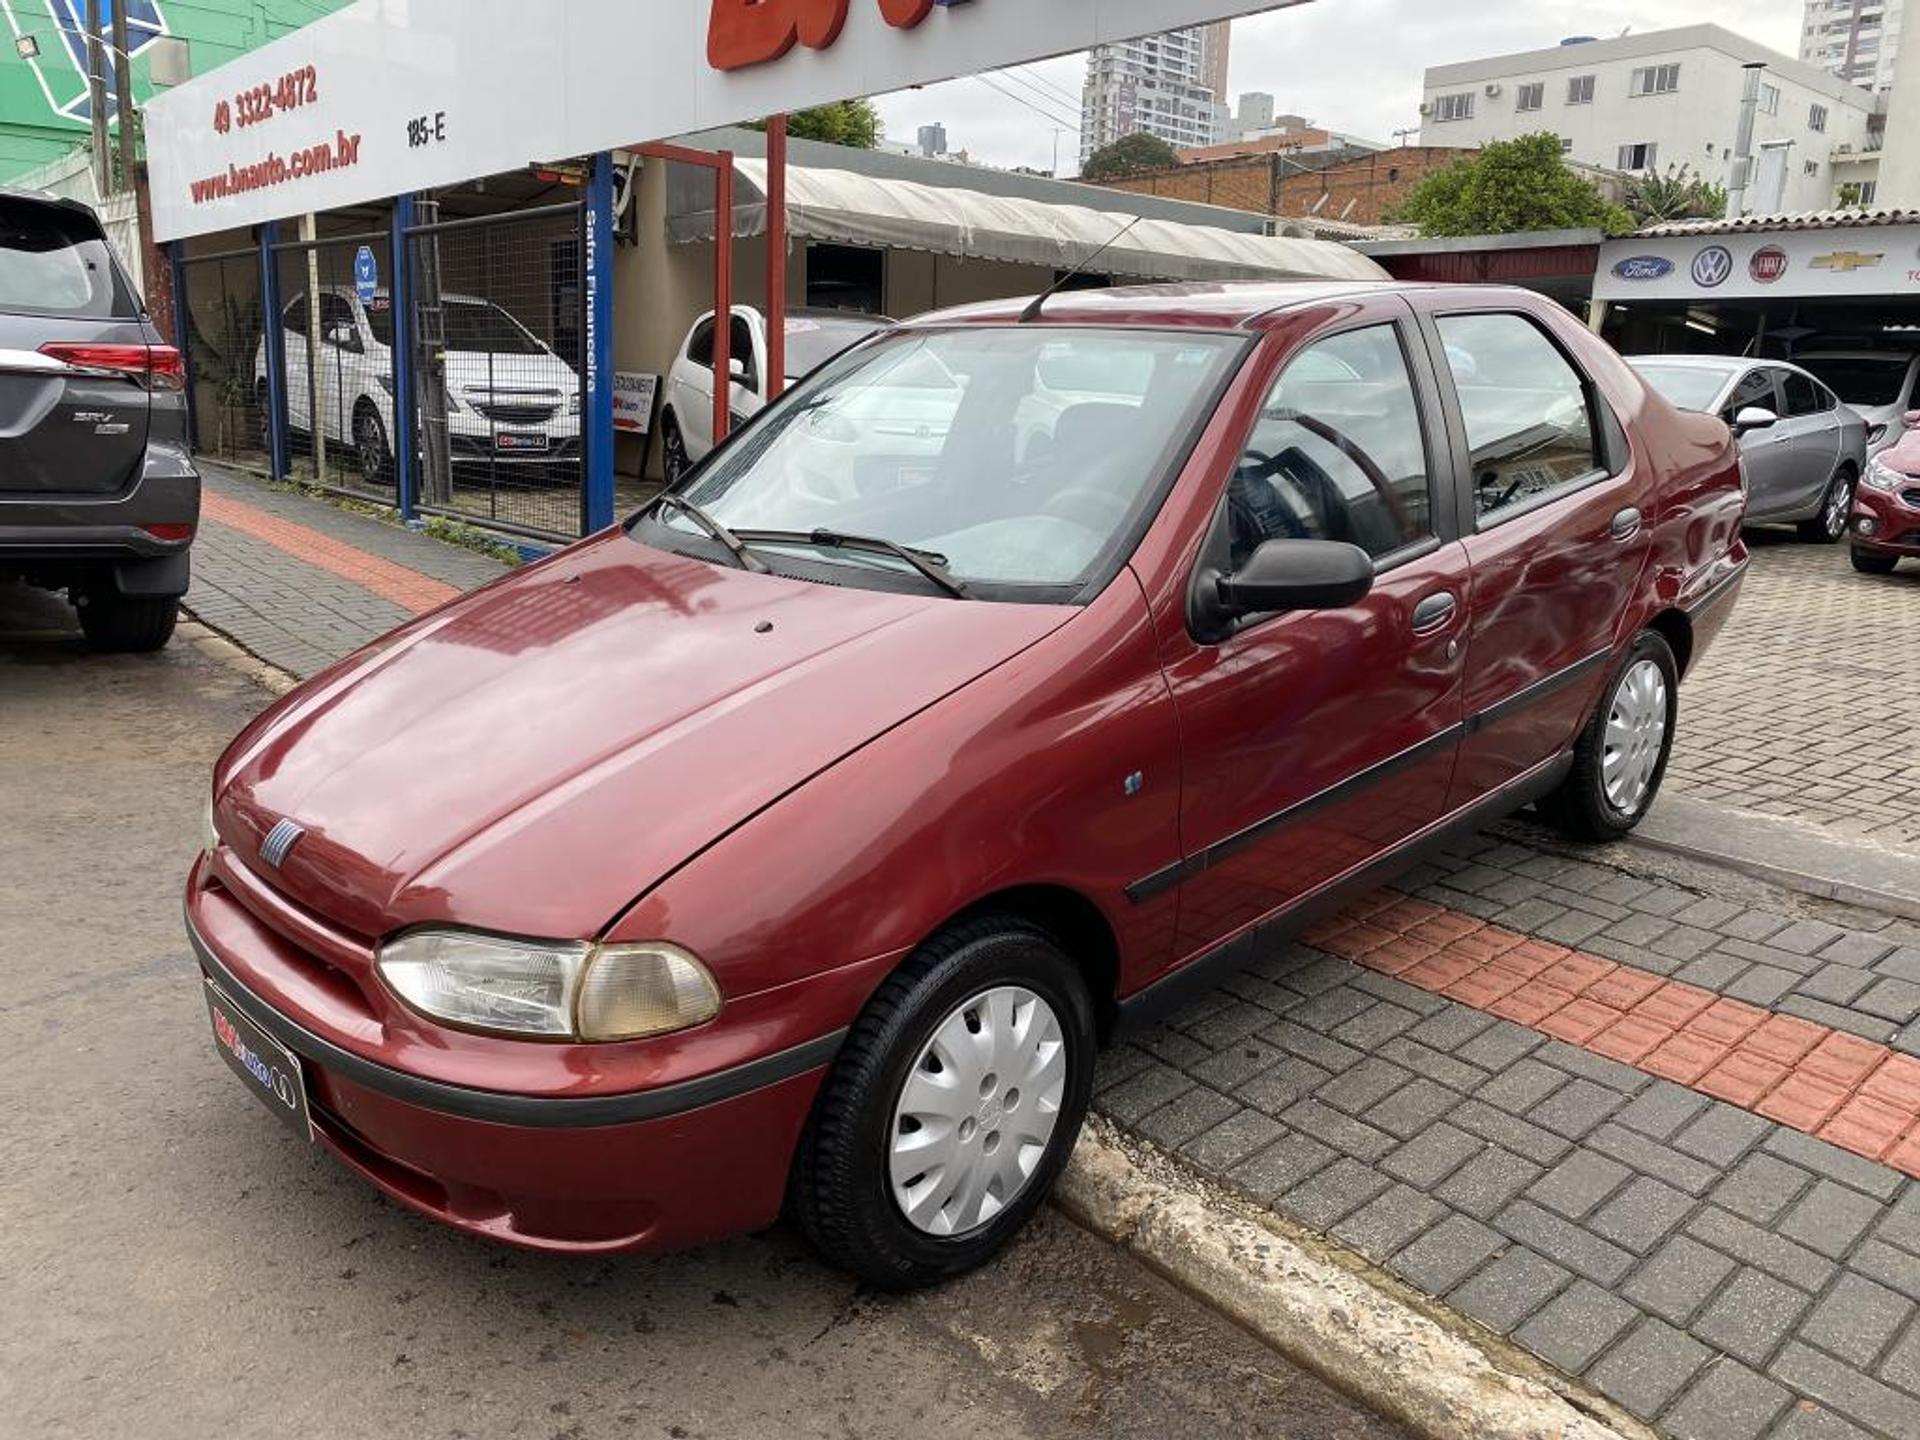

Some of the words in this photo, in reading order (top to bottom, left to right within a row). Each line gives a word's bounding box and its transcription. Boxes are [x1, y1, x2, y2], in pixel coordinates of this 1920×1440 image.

[214, 100, 230, 134] 49
[236, 65, 317, 128] 3322-4872
[407, 111, 446, 148] 185-E
[190, 130, 361, 204] www.bnauto.com.br
[586, 210, 597, 270] Safra
[586, 275, 597, 392] Financeiro
